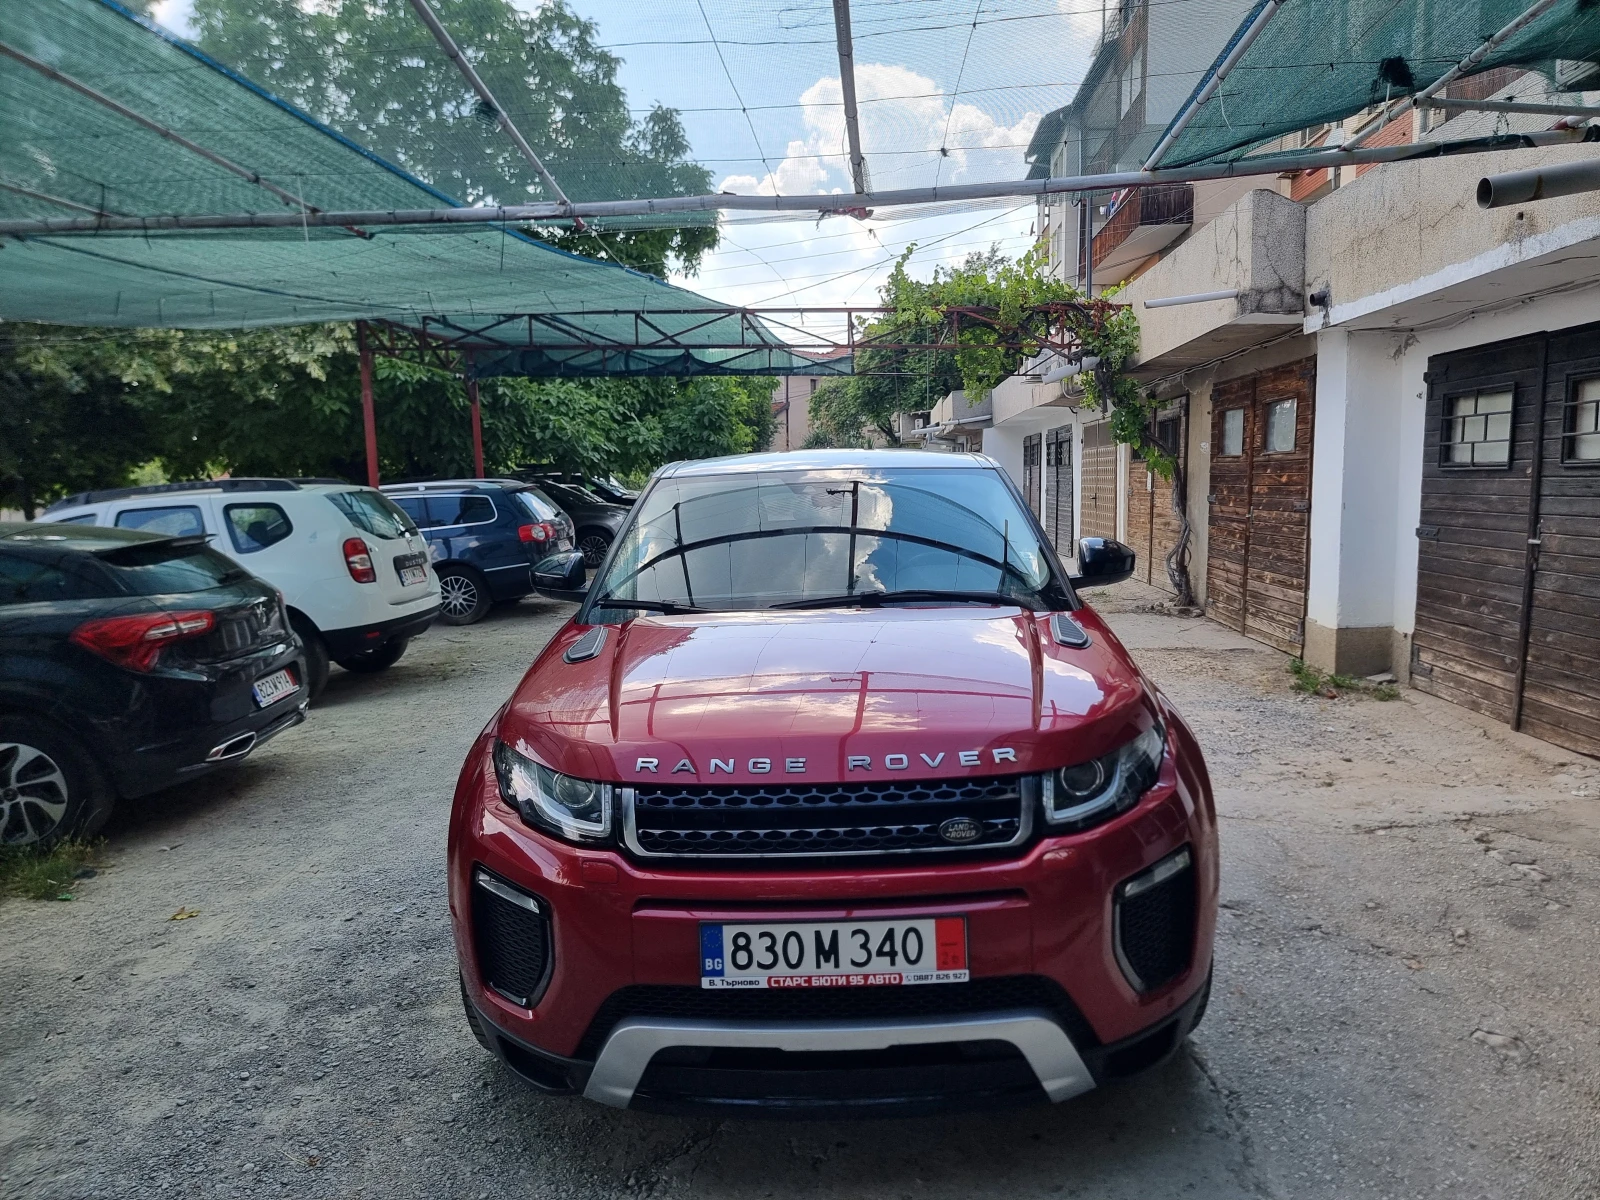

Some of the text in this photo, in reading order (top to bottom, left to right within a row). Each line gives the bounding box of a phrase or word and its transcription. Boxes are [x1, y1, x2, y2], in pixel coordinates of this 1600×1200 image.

[635, 747, 1017, 775] RANGE ROVER
[730, 926, 924, 971] 830 M 340
[705, 958, 723, 971] BG
[708, 978, 760, 988] В. Търново
[770, 974, 900, 987] СТАРС БЮТИ 95 АВТО
[913, 972, 967, 982] 0887 826 927
